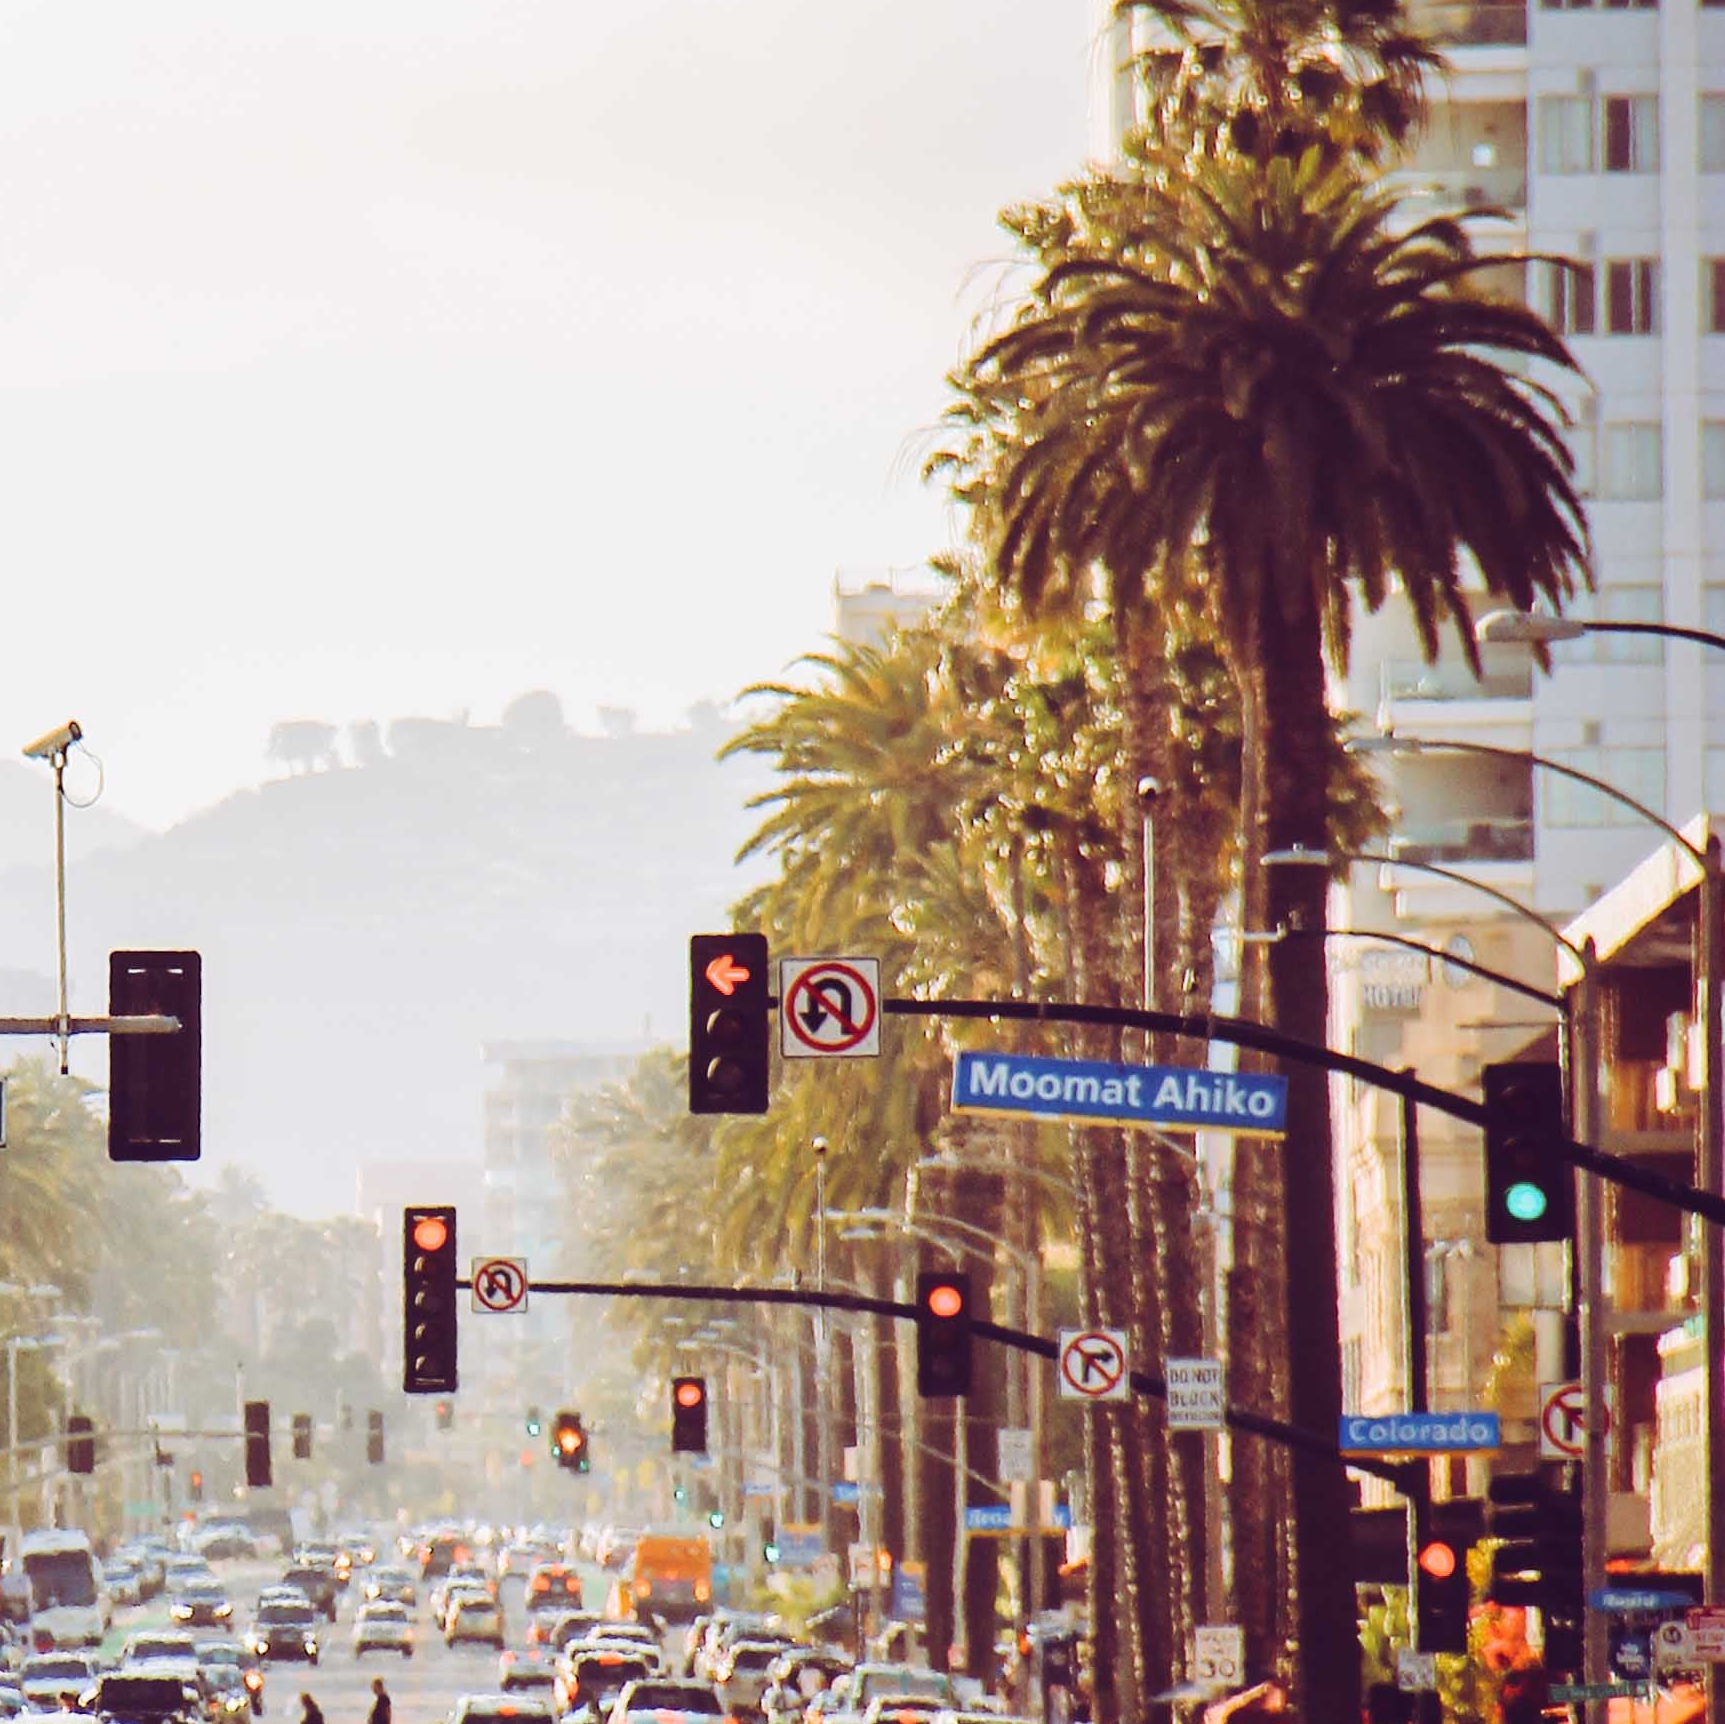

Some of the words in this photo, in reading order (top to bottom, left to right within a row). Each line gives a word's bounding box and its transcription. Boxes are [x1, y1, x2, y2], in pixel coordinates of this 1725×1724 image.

[969, 1060, 1142, 1108] Moomat
[1152, 1075, 1276, 1118] Ahiko
[1170, 1367, 1188, 1384] DO
[1192, 1367, 1219, 1384] NOT
[1170, 1390, 1220, 1407] BLOCK
[1348, 1417, 1490, 1444] Colorado
